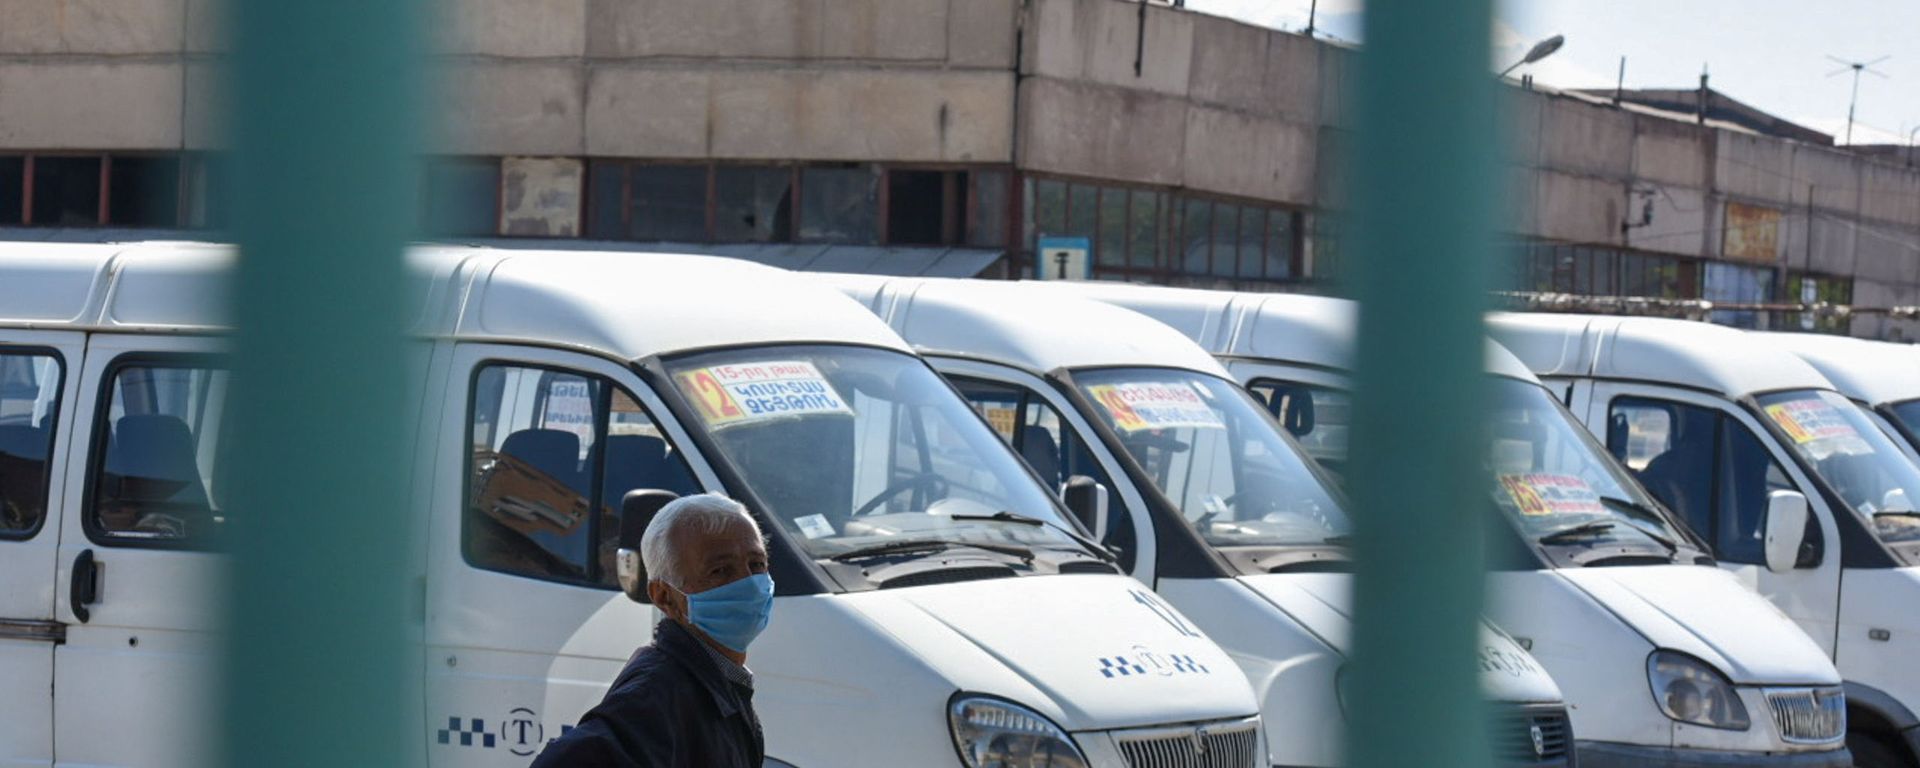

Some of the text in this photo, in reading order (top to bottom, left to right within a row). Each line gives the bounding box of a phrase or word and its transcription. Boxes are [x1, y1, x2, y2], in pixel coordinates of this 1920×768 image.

[675, 371, 740, 419] 12
[735, 381, 827, 397] ԿՈՄԻՏԱՍ
[1127, 588, 1202, 638] 12
